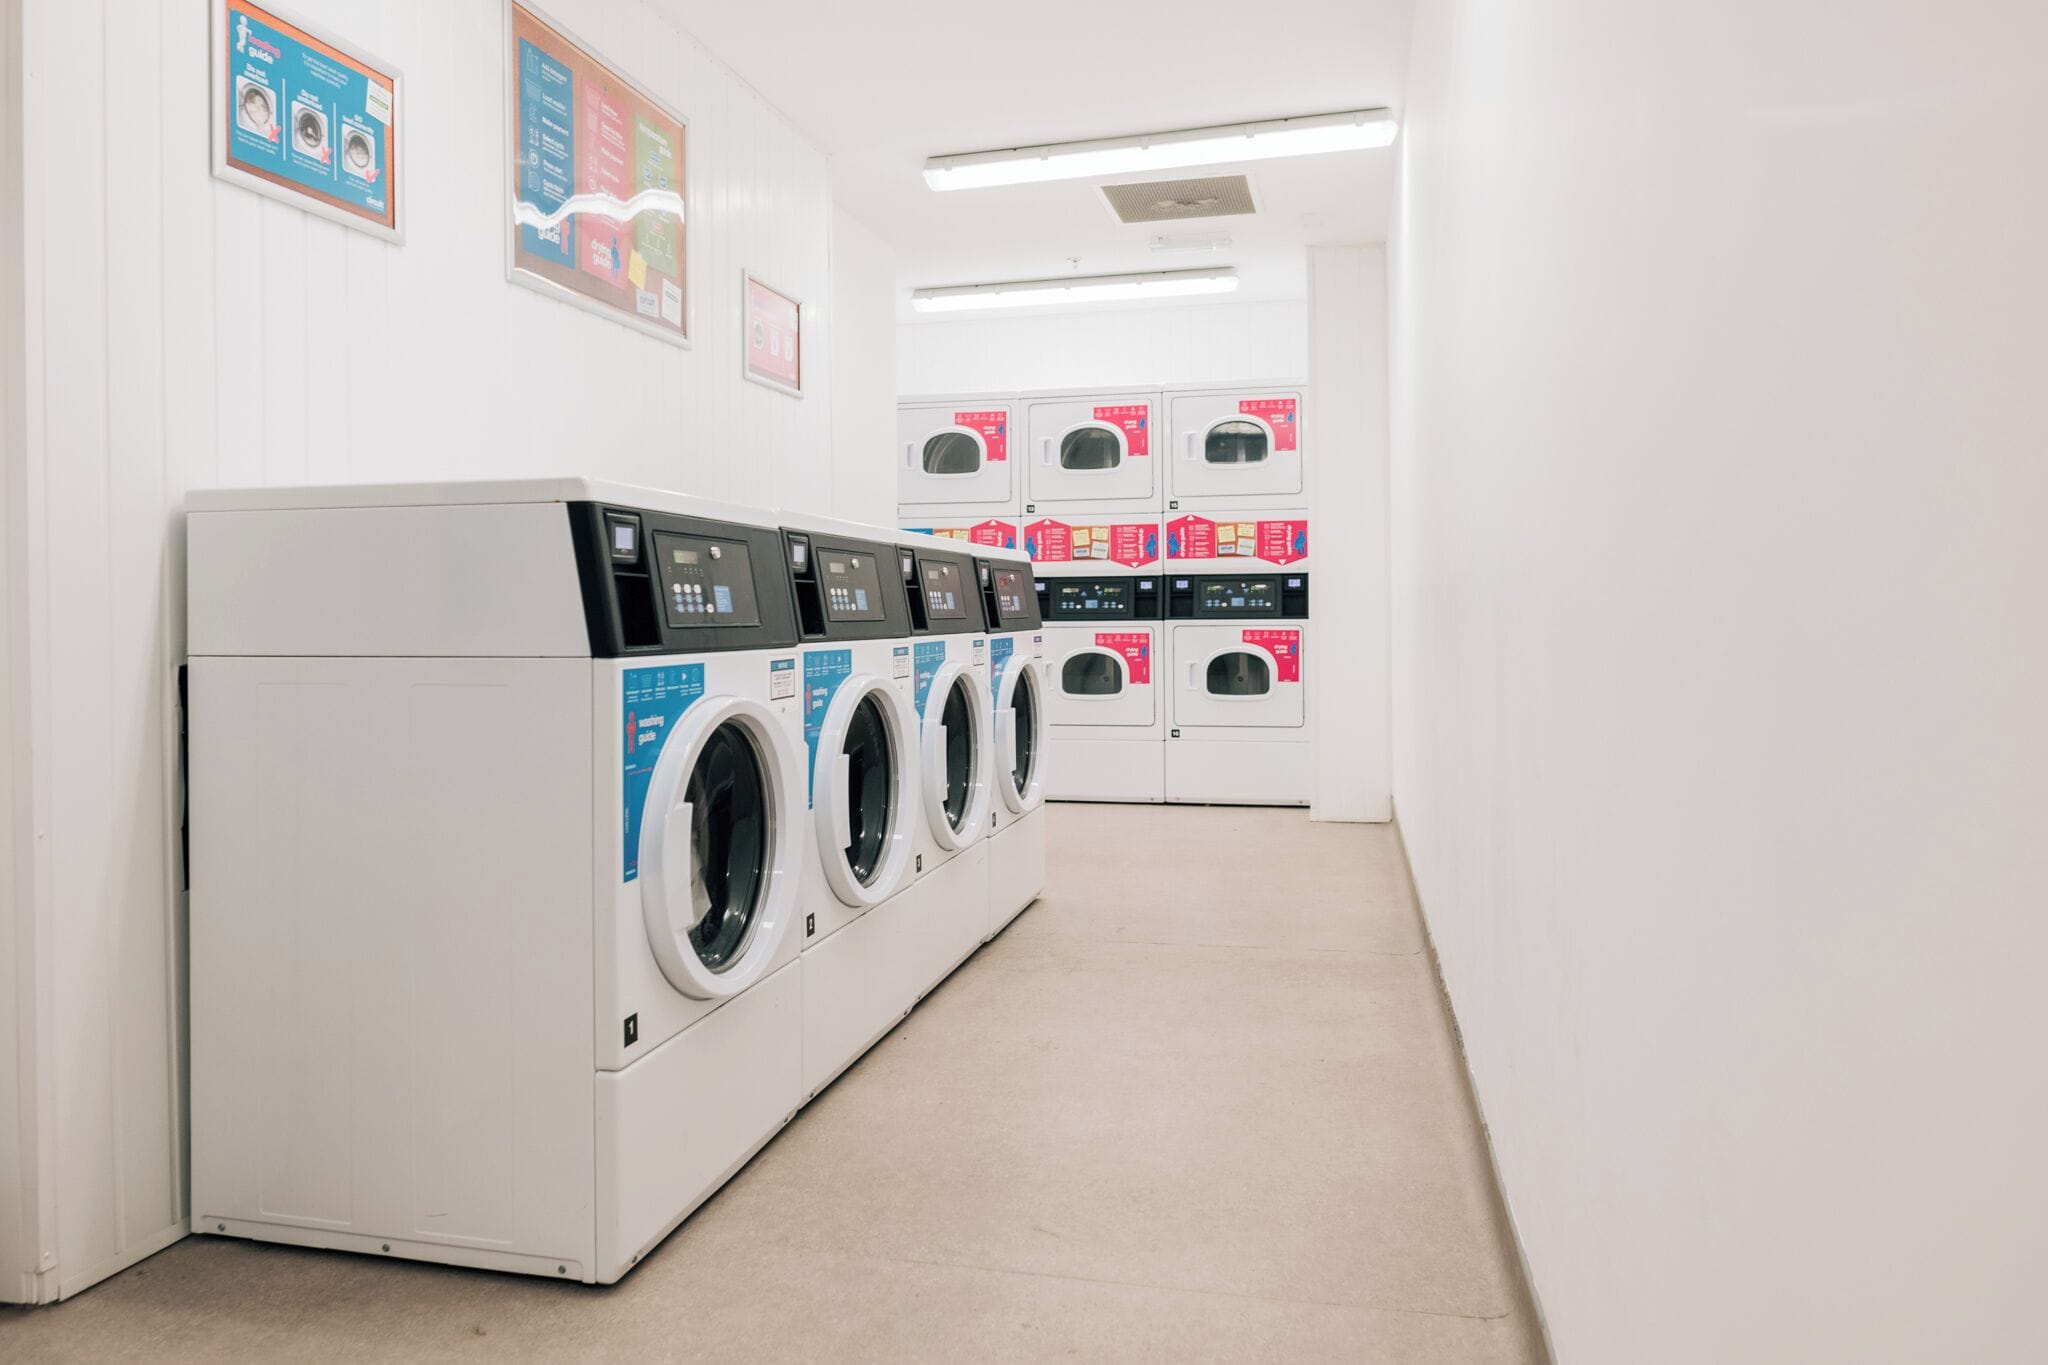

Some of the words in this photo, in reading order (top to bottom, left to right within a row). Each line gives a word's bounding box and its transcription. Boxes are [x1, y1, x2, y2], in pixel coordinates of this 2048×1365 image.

[248, 46, 274, 65] guide
[247, 63, 255, 73] Do
[256, 68, 266, 78] not
[538, 226, 560, 245] guide
[591, 239, 612, 256] drying
[593, 253, 611, 269] guide
[639, 713, 664, 728] washing
[638, 729, 656, 746] guide
[808, 918, 814, 930] 2
[629, 1020, 634, 1035] 1
